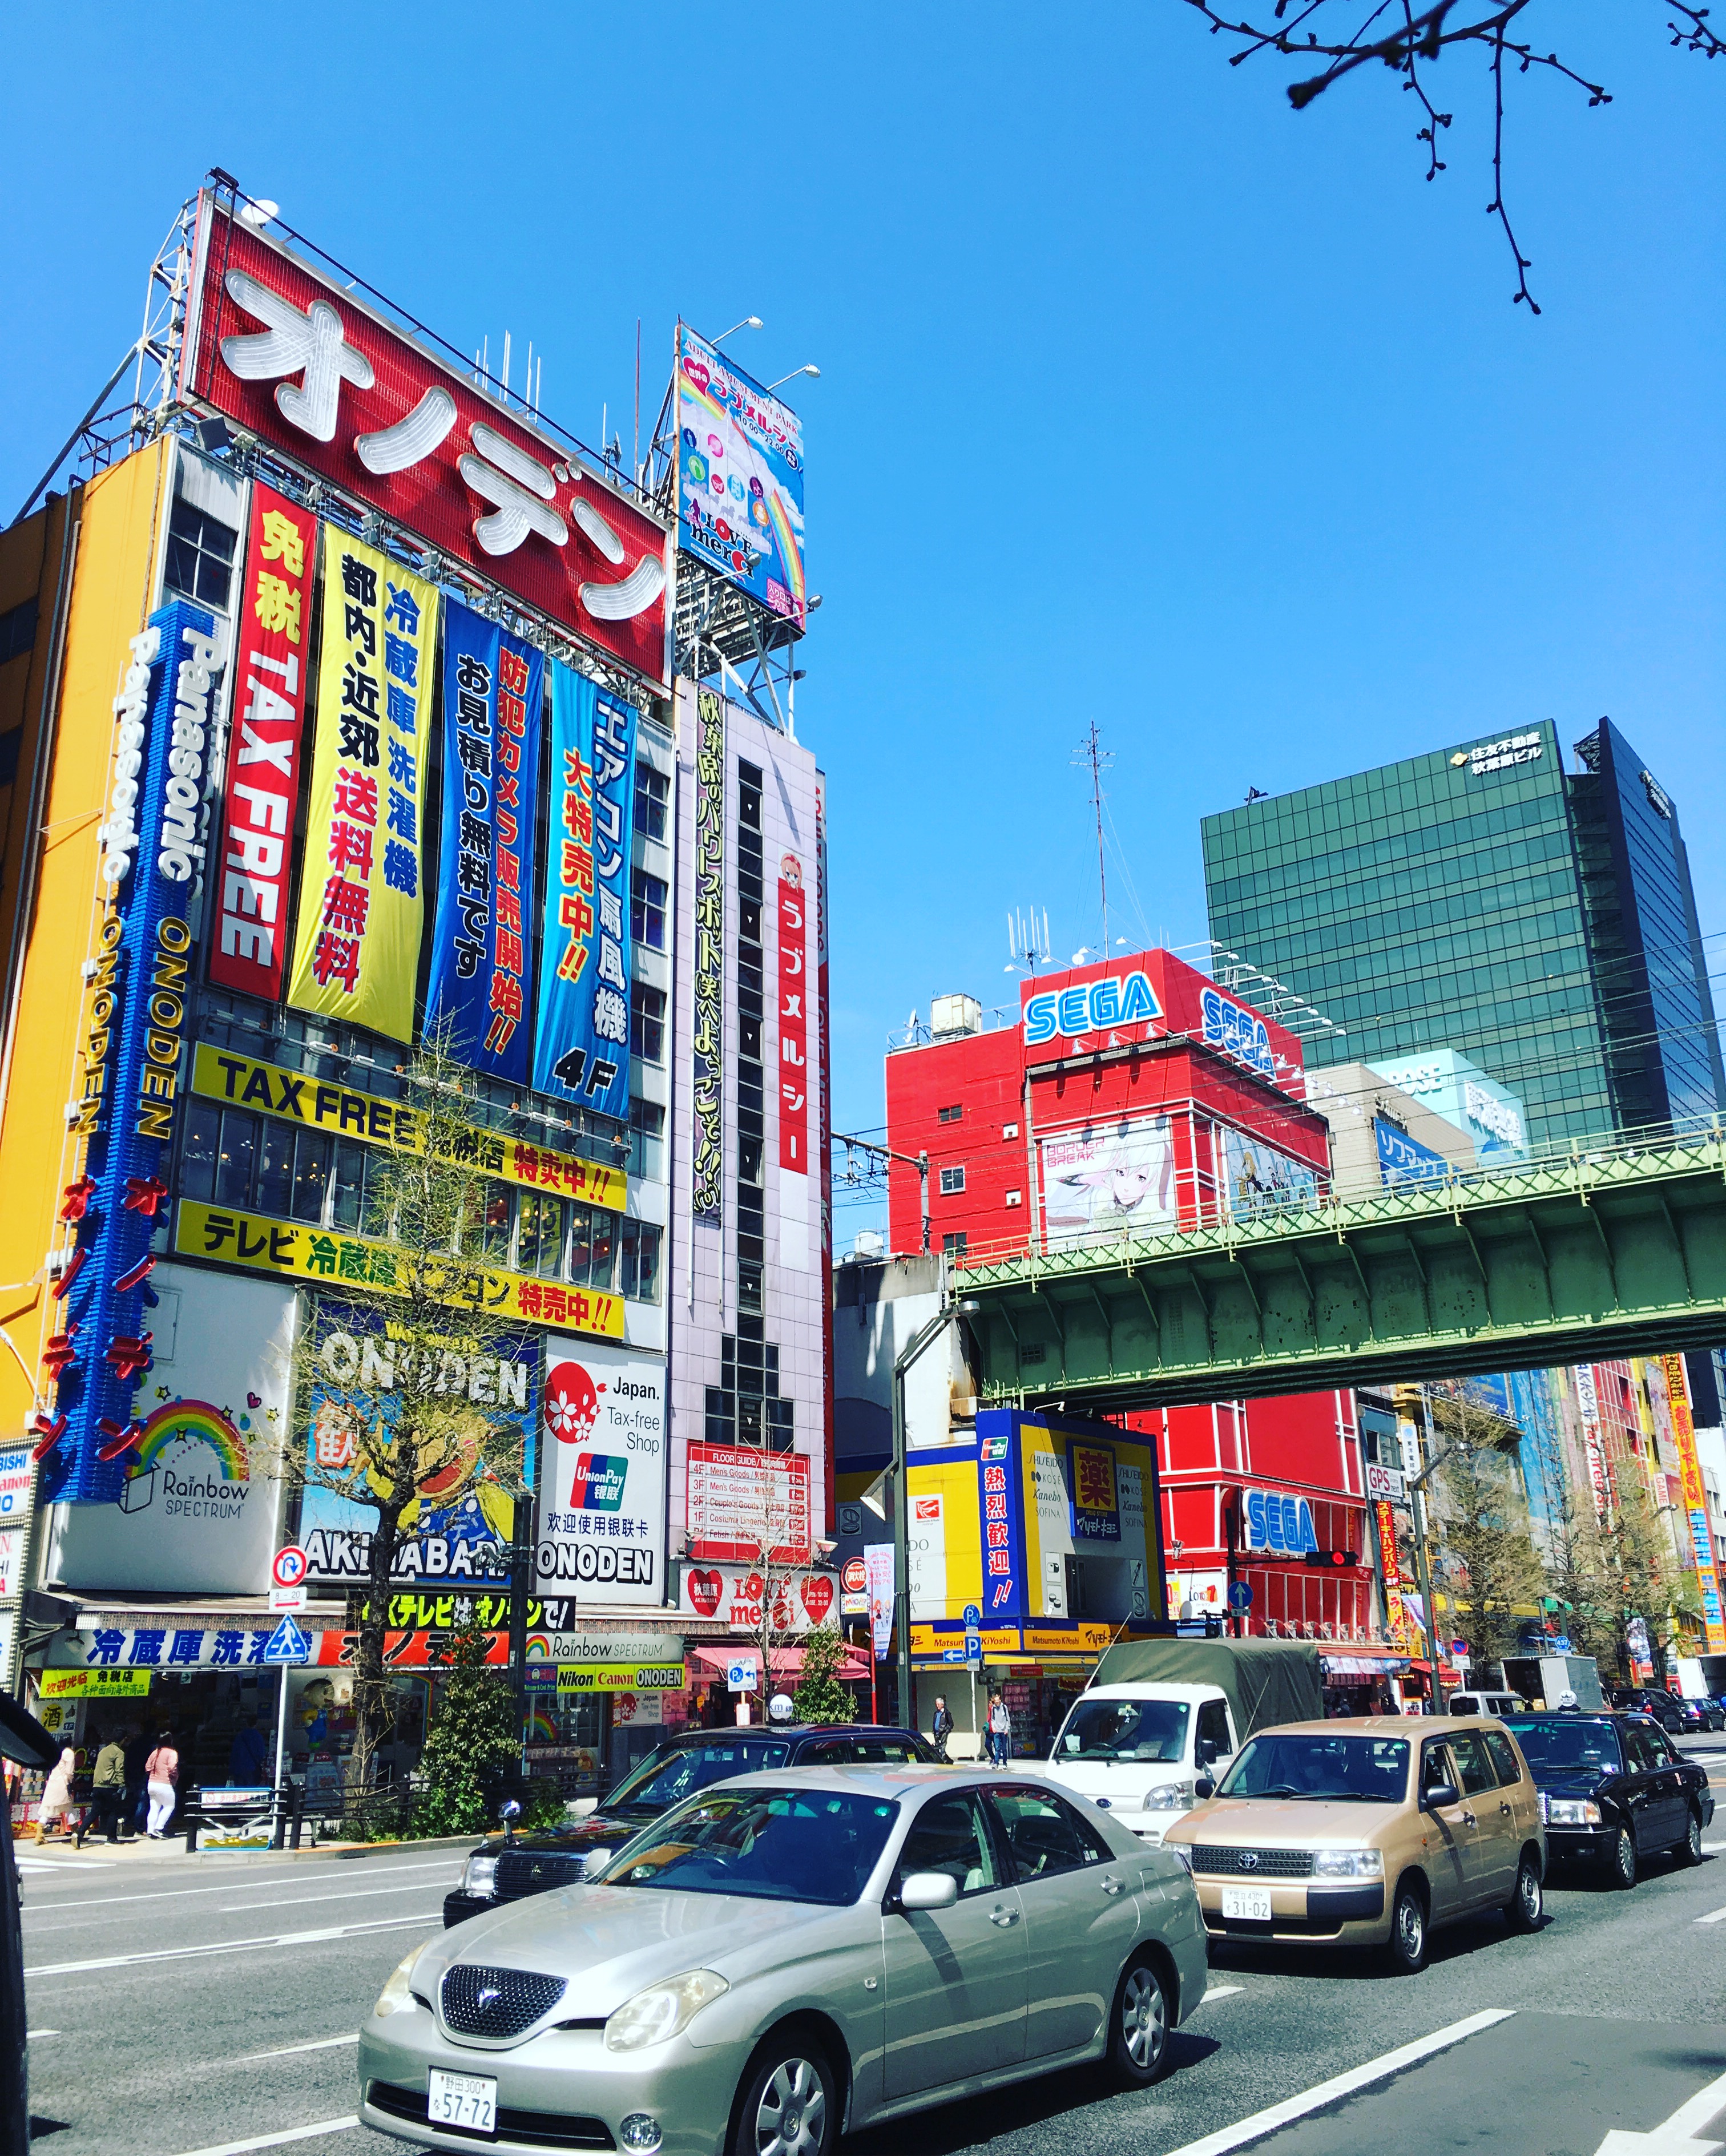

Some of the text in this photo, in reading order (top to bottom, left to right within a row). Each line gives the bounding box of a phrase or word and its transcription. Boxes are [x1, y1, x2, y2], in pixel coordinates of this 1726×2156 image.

[713, 374, 797, 450] ラブメルシー
[220, 268, 667, 620] オノデン
[705, 511, 753, 556] LOVE
[256, 508, 305, 646] 免税
[384, 581, 421, 899] 冷蔵庫 洗濯機
[1470, 731, 1542, 761] 住友不動産
[158, 627, 223, 882] Panasonic
[1471, 748, 1542, 775] 秋葉原ビル
[220, 649, 299, 968] TAX FREE
[454, 653, 492, 979] お見積り無料です
[555, 745, 595, 985] 大特売中!!
[591, 697, 629, 1044] エアコン 扇風機
[312, 764, 379, 994] 送料無料
[1025, 972, 1163, 1044] SEGA
[74, 914, 126, 1137] ONODEN
[135, 916, 192, 1140] ONODEN
[780, 899, 805, 1160] ラブメルシー
[1200, 987, 1277, 1080] SEGA
[553, 1045, 618, 1098] 4F
[218, 1057, 417, 1147] TAX FREE
[1047, 1136, 1104, 1157] BORDER
[1047, 1150, 1095, 1168] BREAK
[204, 1214, 298, 1266] テレビ
[518, 1281, 612, 1332] 特売中!!
[32, 1174, 98, 1462] オノデン
[96, 1176, 168, 1461] オノデン
[613, 1376, 660, 1400] Japan.
[607, 1406, 660, 1431] Tax-free
[627, 1432, 659, 1456] Shop
[694, 1464, 749, 1479] 4F Men's Goods
[713, 1454, 735, 1463] FLOOR
[737, 1456, 756, 1466] GUIDE
[163, 1470, 249, 1501] Rainbow
[576, 1465, 624, 1489] UnionPay
[693, 1480, 749, 1493] 3F Men's Goods
[1043, 1473, 1061, 1484] KOSÉ
[1079, 1450, 1111, 1507] 薬
[1370, 1467, 1389, 1491] GPS
[594, 1485, 620, 1501] 银联
[693, 1496, 704, 1505] 2F
[1033, 1488, 1061, 1503] Kanebo
[1655, 1477, 1667, 1504] GAME
[166, 1499, 242, 1519] SPECTRUM
[695, 1512, 704, 1522] 1F
[1035, 1507, 1060, 1518] SOFINA
[1247, 1491, 1317, 1552] SEGA
[547, 1512, 648, 1538] 欢迎使用银联卡
[1378, 1502, 1396, 1577] ステーキ&ハンバーグ
[537, 1541, 653, 1585] ONODEN
[694, 1583, 718, 1596] 秋葉原
[848, 1572, 865, 1582] 消火栓
[967, 1609, 974, 1623] P
[87, 1629, 204, 1665] 冷蔵庫
[553, 1636, 612, 1657] Rainbow
[614, 1644, 663, 1657] SPECTRUM
[969, 1638, 978, 1656] P
[97, 1670, 134, 1683] 免税店
[558, 1671, 594, 1686] Nikon
[598, 1672, 633, 1685] Canon
[636, 1669, 682, 1687] ONODEN
[43, 1706, 61, 1728] 酒
[1233, 1901, 1268, 1917] 31-02
[446, 2076, 480, 2094] 野田 300
[443, 2093, 491, 2127] 57-72
